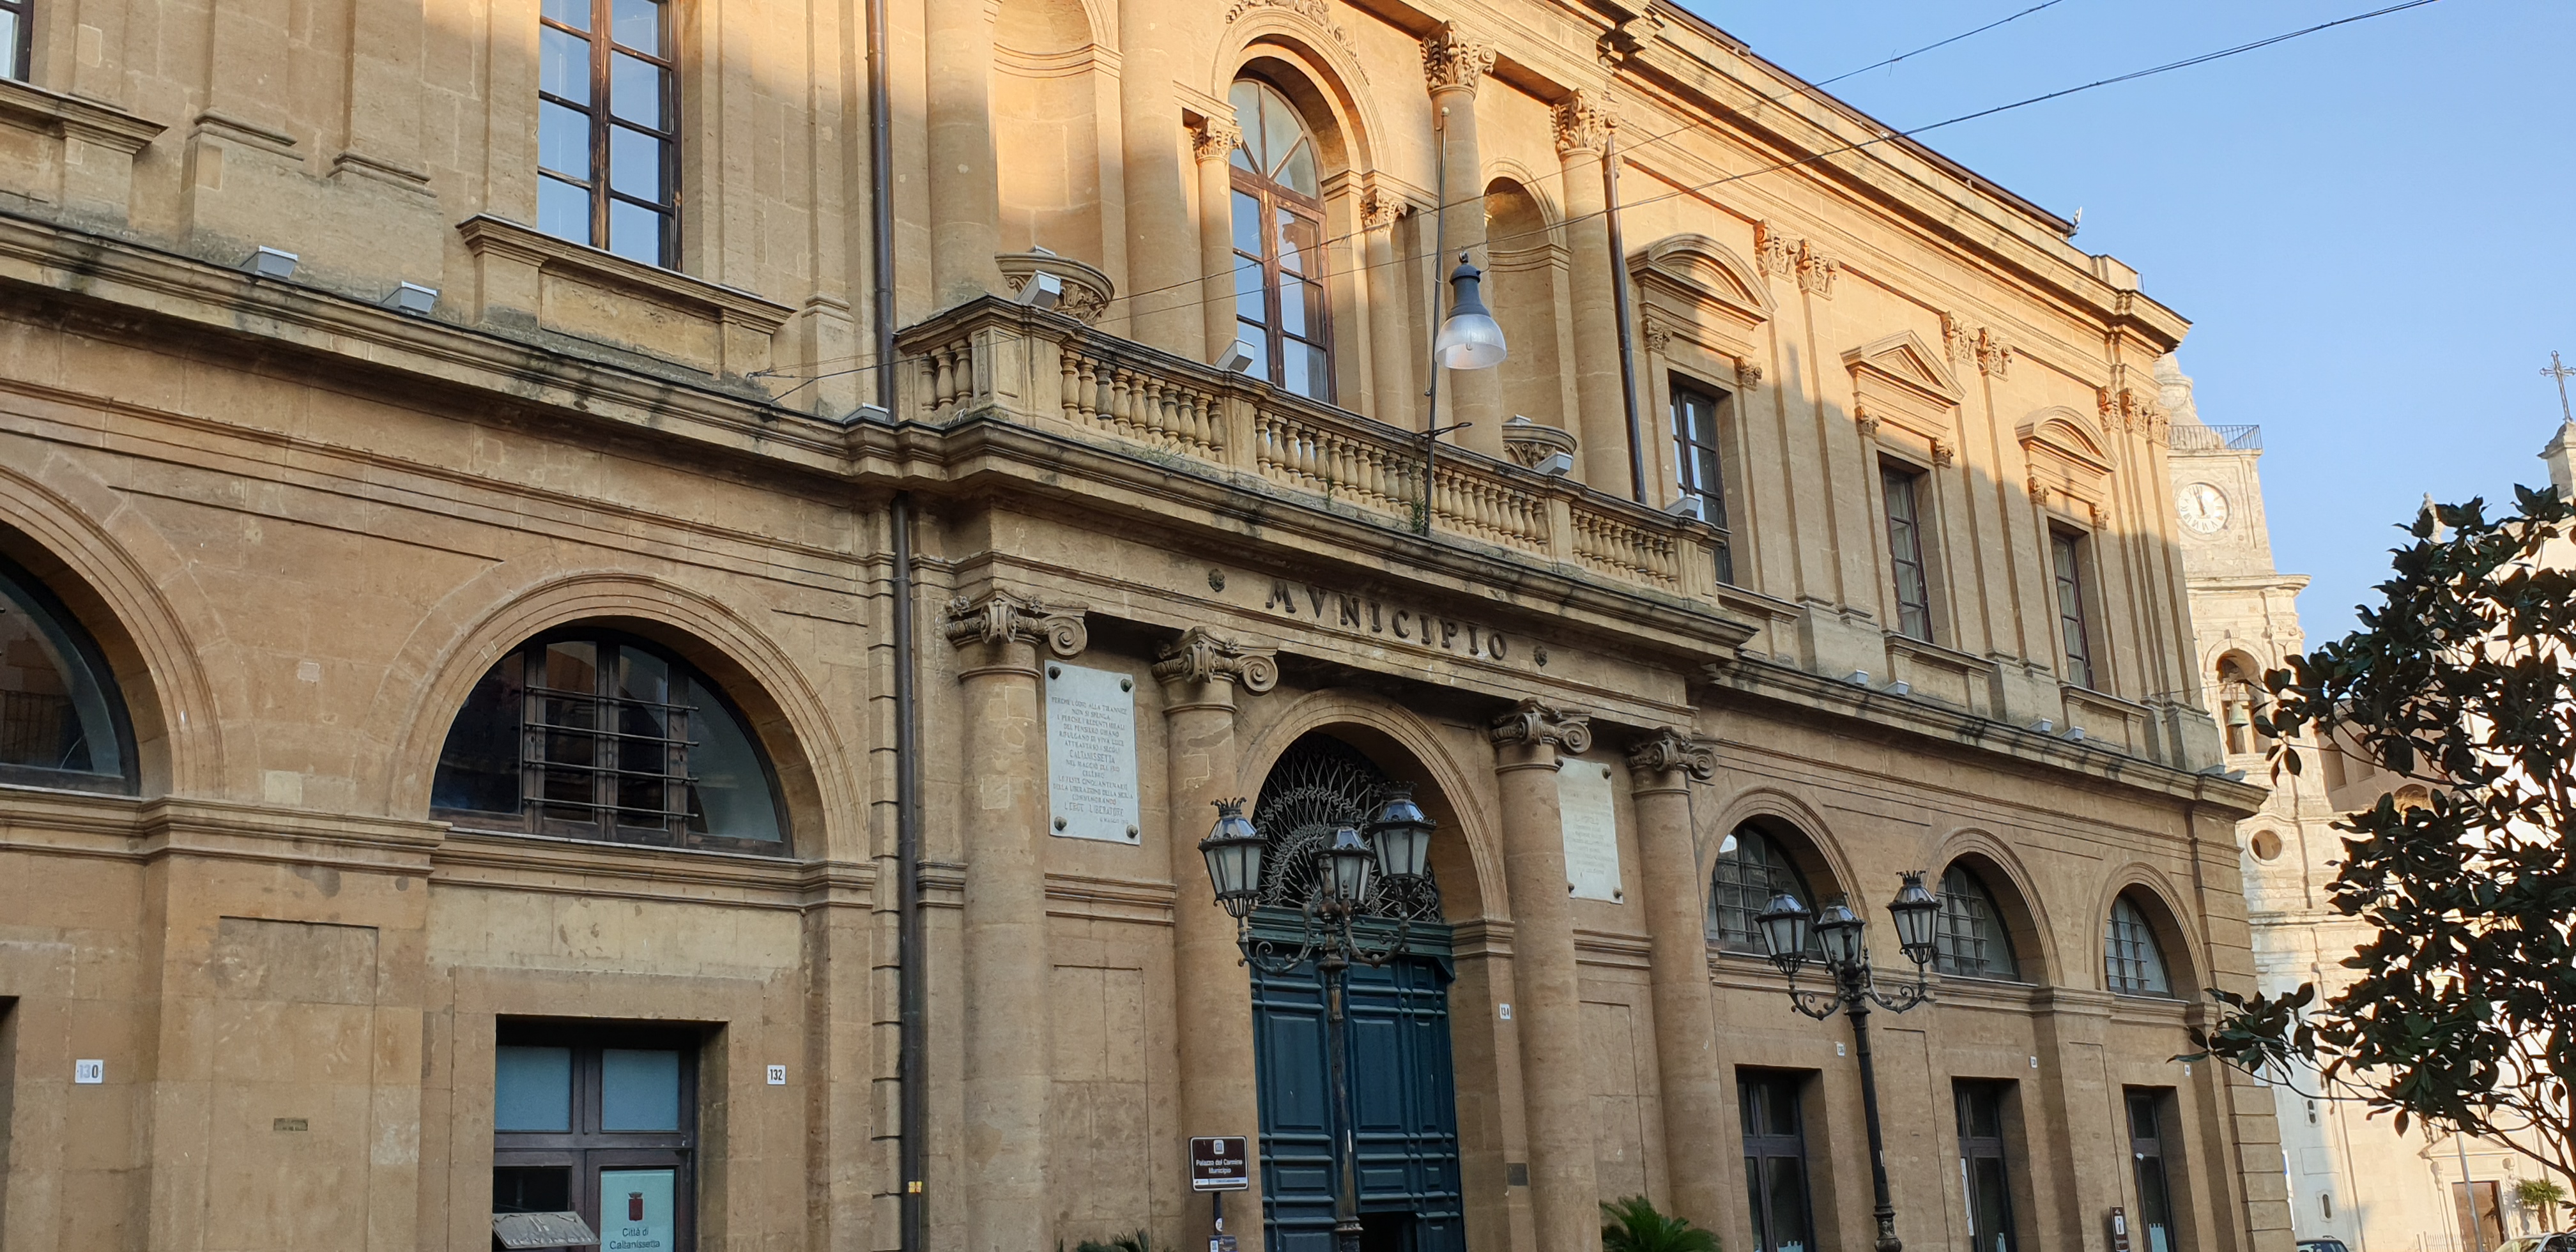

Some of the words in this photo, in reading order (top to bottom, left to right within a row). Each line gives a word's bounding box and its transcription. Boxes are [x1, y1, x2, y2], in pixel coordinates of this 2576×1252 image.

[79, 1064, 99, 1079] 130
[770, 1069, 783, 1081] 132
[622, 1227, 641, 1237] Città
[642, 1228, 649, 1237] di
[610, 1240, 661, 1250] Caltanissetta
